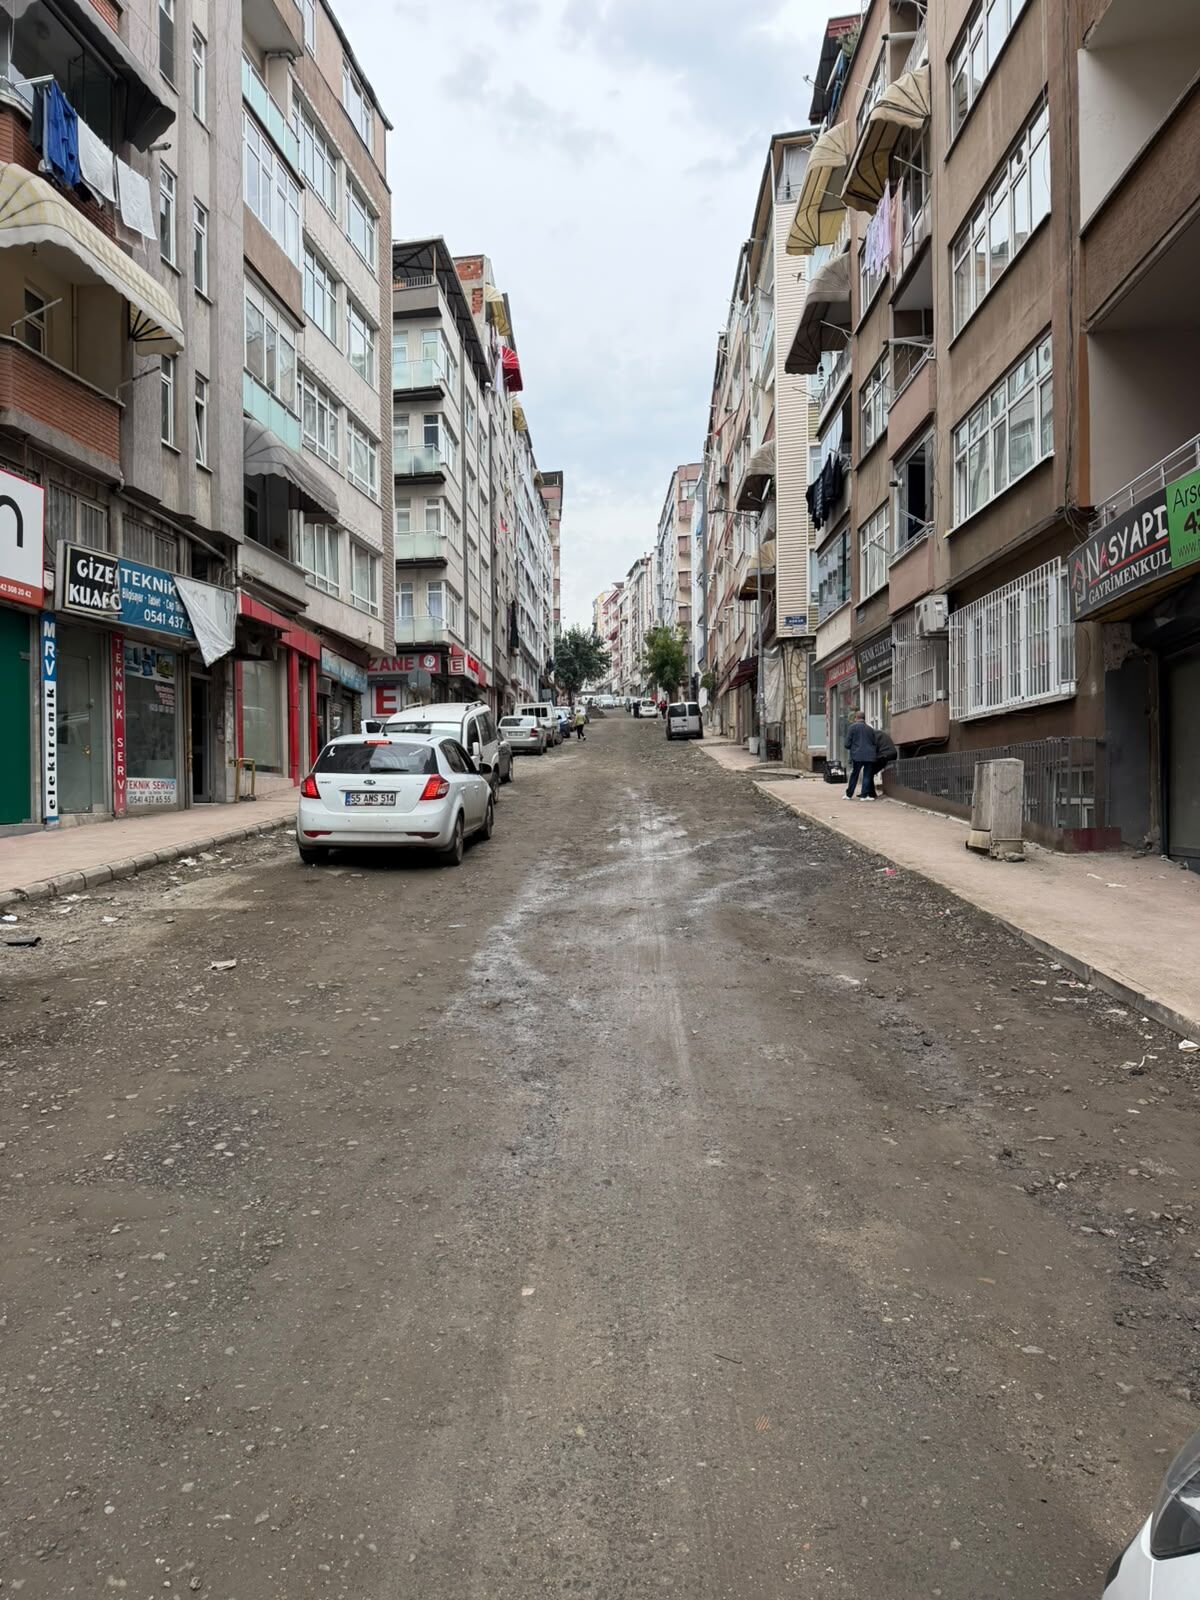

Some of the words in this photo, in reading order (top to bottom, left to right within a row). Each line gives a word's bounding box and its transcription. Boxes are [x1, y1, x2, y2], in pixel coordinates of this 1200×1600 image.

[1173, 483, 1200, 513] Ars
[76, 556, 119, 585] GİZE
[1088, 548, 1172, 605] GAYRİMENKUL
[144, 608, 166, 626] 0541
[168, 615, 185, 630] 437
[44, 621, 56, 677] MRV
[376, 685, 397, 715] E
[351, 794, 361, 803] 55
[363, 794, 379, 803] ANS
[381, 794, 395, 803] 514
